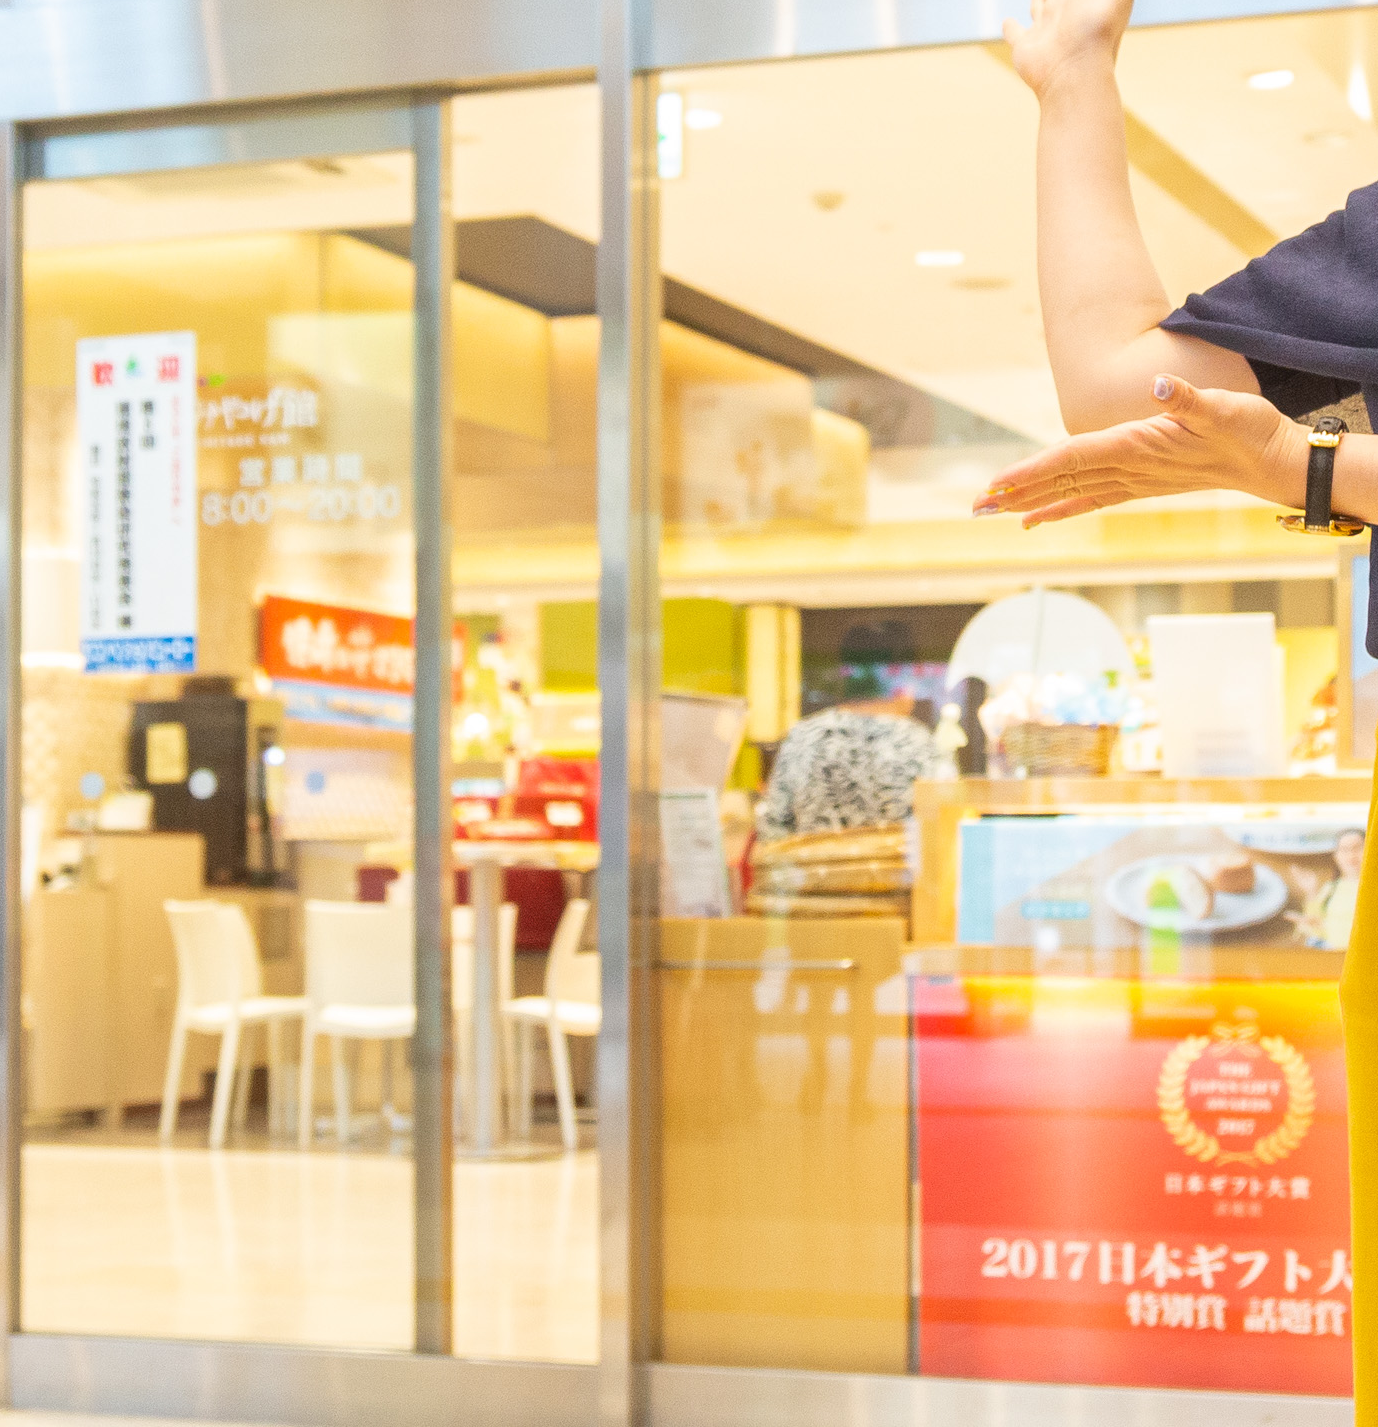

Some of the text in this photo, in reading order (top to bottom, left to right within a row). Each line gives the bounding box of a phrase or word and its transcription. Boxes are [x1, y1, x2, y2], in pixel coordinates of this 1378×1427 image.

[1126, 1292, 1345, 1338] 特別賞 話題賞
